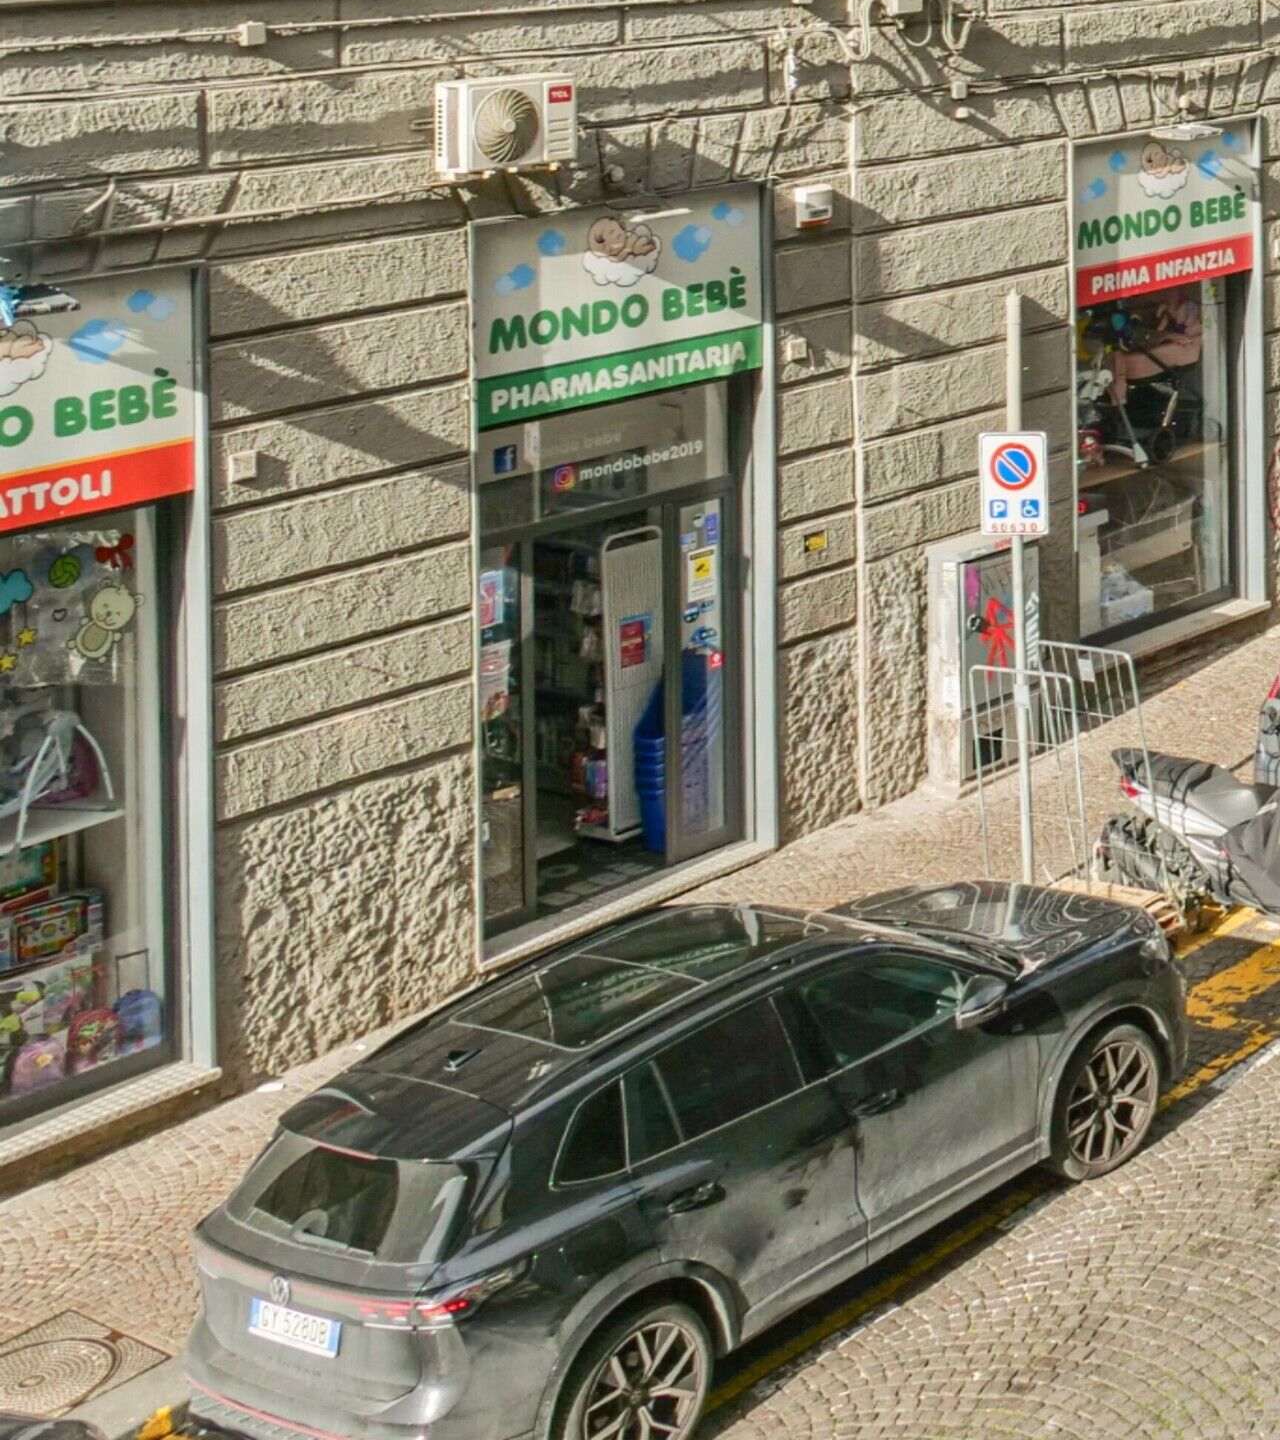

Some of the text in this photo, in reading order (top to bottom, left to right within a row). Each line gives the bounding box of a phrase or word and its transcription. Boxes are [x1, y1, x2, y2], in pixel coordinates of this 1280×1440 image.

[551, 89, 569, 99] TCL
[1077, 184, 1246, 250] MONDO BEBÈ
[1092, 247, 1236, 295] PRIMA INFANZIA
[489, 266, 747, 354] MONDO BEBÈ
[54, 367, 178, 438] BEBÈ
[491, 341, 747, 414] PHARMASANITARIA
[579, 438, 704, 482] mondobebe2019
